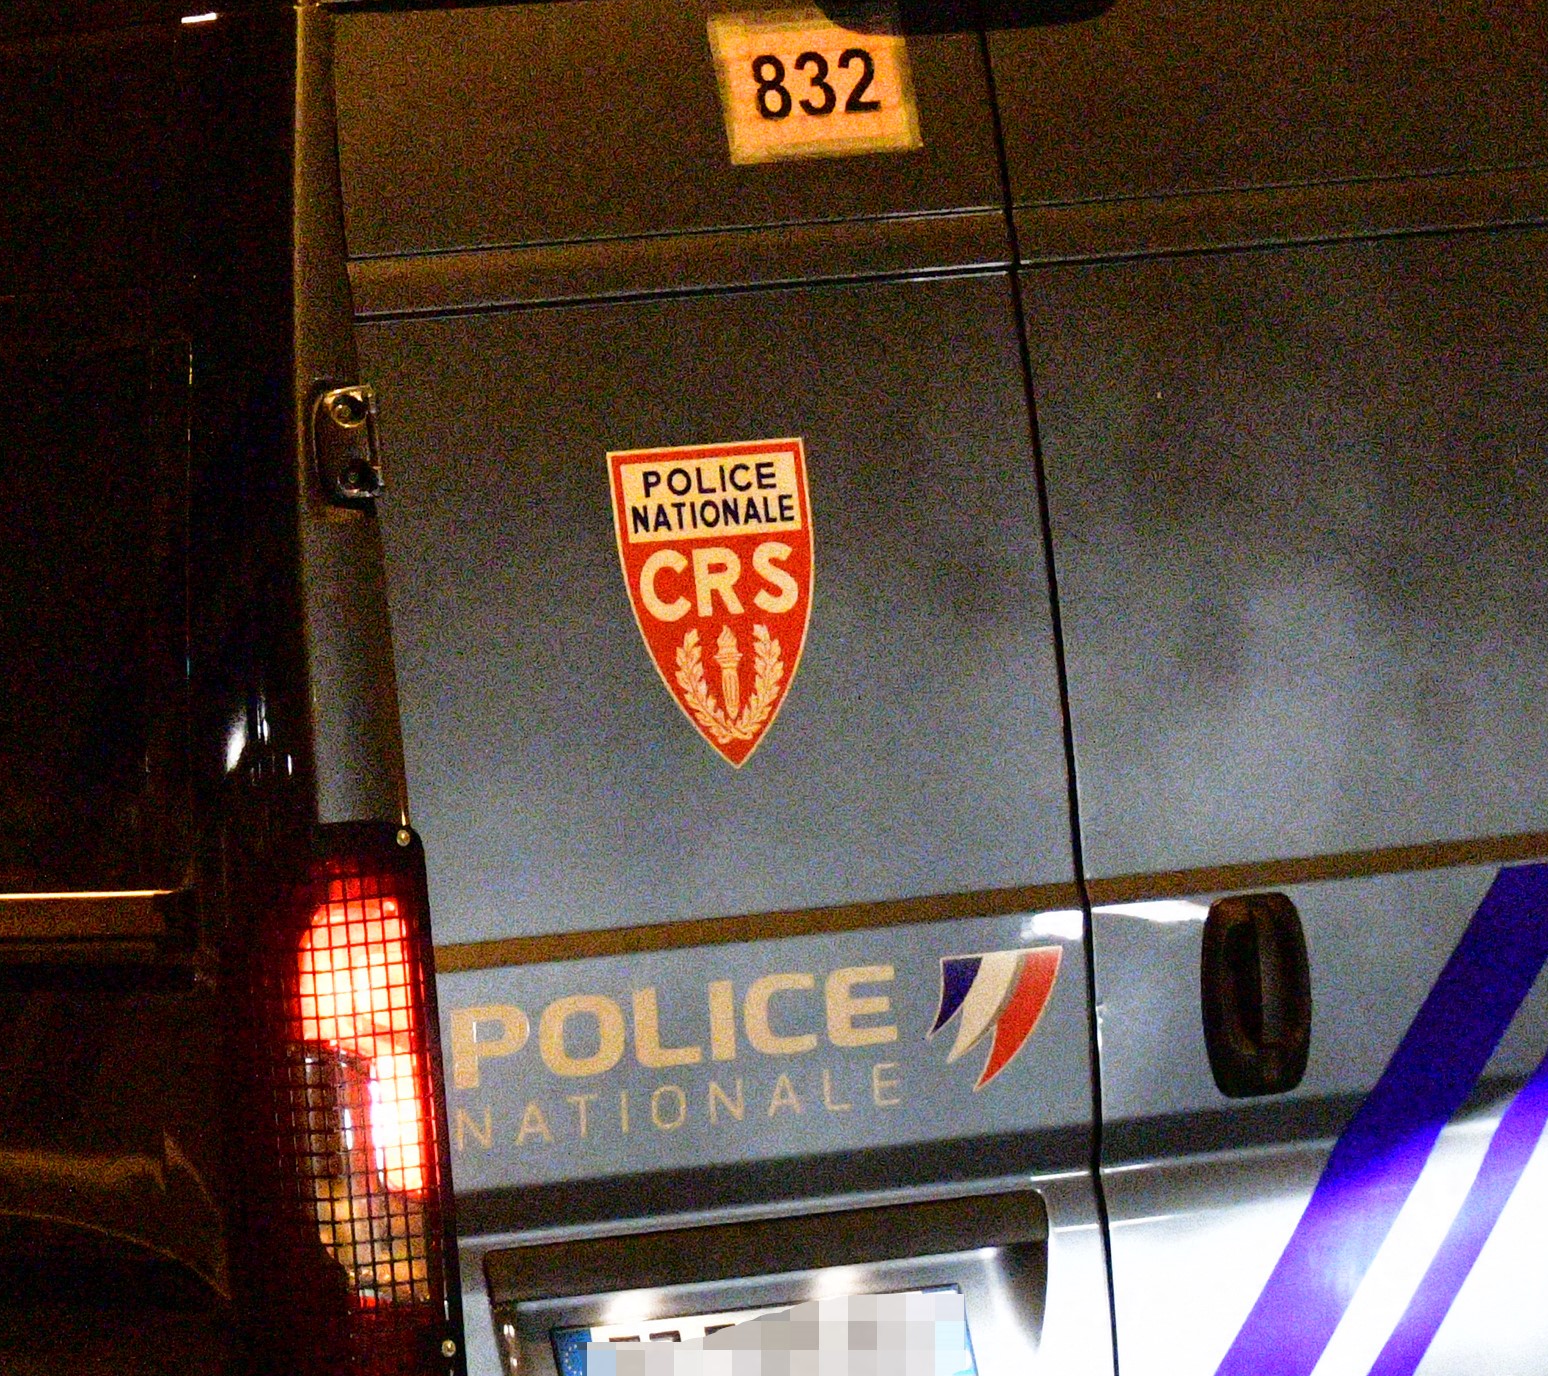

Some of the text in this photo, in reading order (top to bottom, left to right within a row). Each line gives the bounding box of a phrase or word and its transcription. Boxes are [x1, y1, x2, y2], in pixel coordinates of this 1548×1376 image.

[751, 47, 882, 121] 832
[630, 493, 796, 535] NATIONALE
[641, 461, 778, 498] POLICE
[639, 540, 800, 622] CRS
[450, 964, 899, 1090] POLICE
[455, 1062, 903, 1152] NATIONALE
